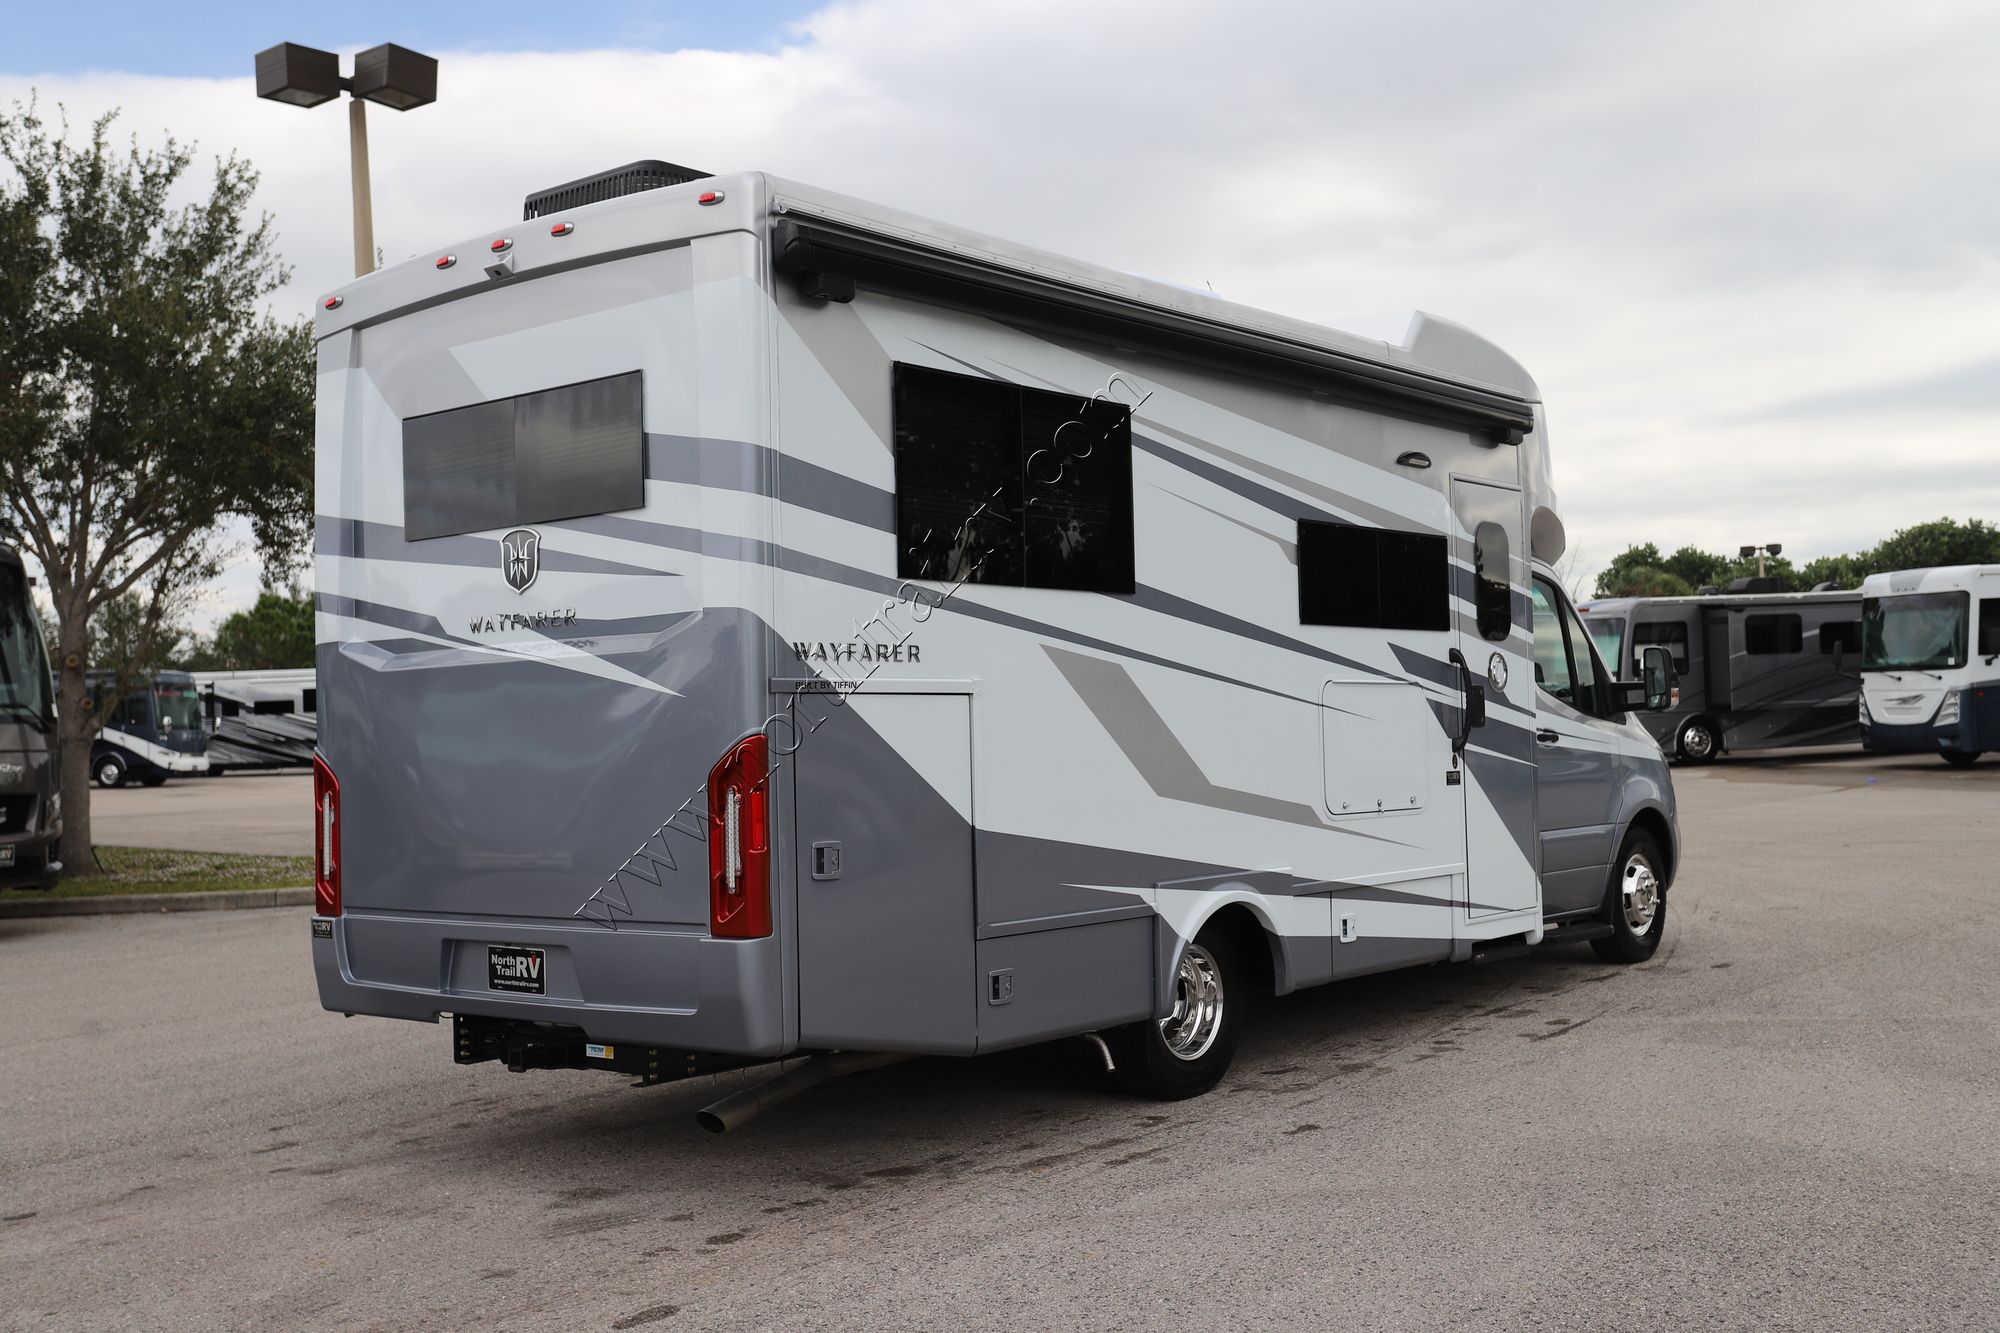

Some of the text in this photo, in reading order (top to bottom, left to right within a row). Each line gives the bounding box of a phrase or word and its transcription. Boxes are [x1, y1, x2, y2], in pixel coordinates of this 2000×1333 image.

[468, 607, 577, 634] WAYFARER
[793, 642, 921, 663] WAYFARER
[795, 682, 818, 690] BUILT
[833, 681, 857, 689] TIFFIN
[491, 954, 540, 978] North RV
[496, 965, 515, 976] Trail
